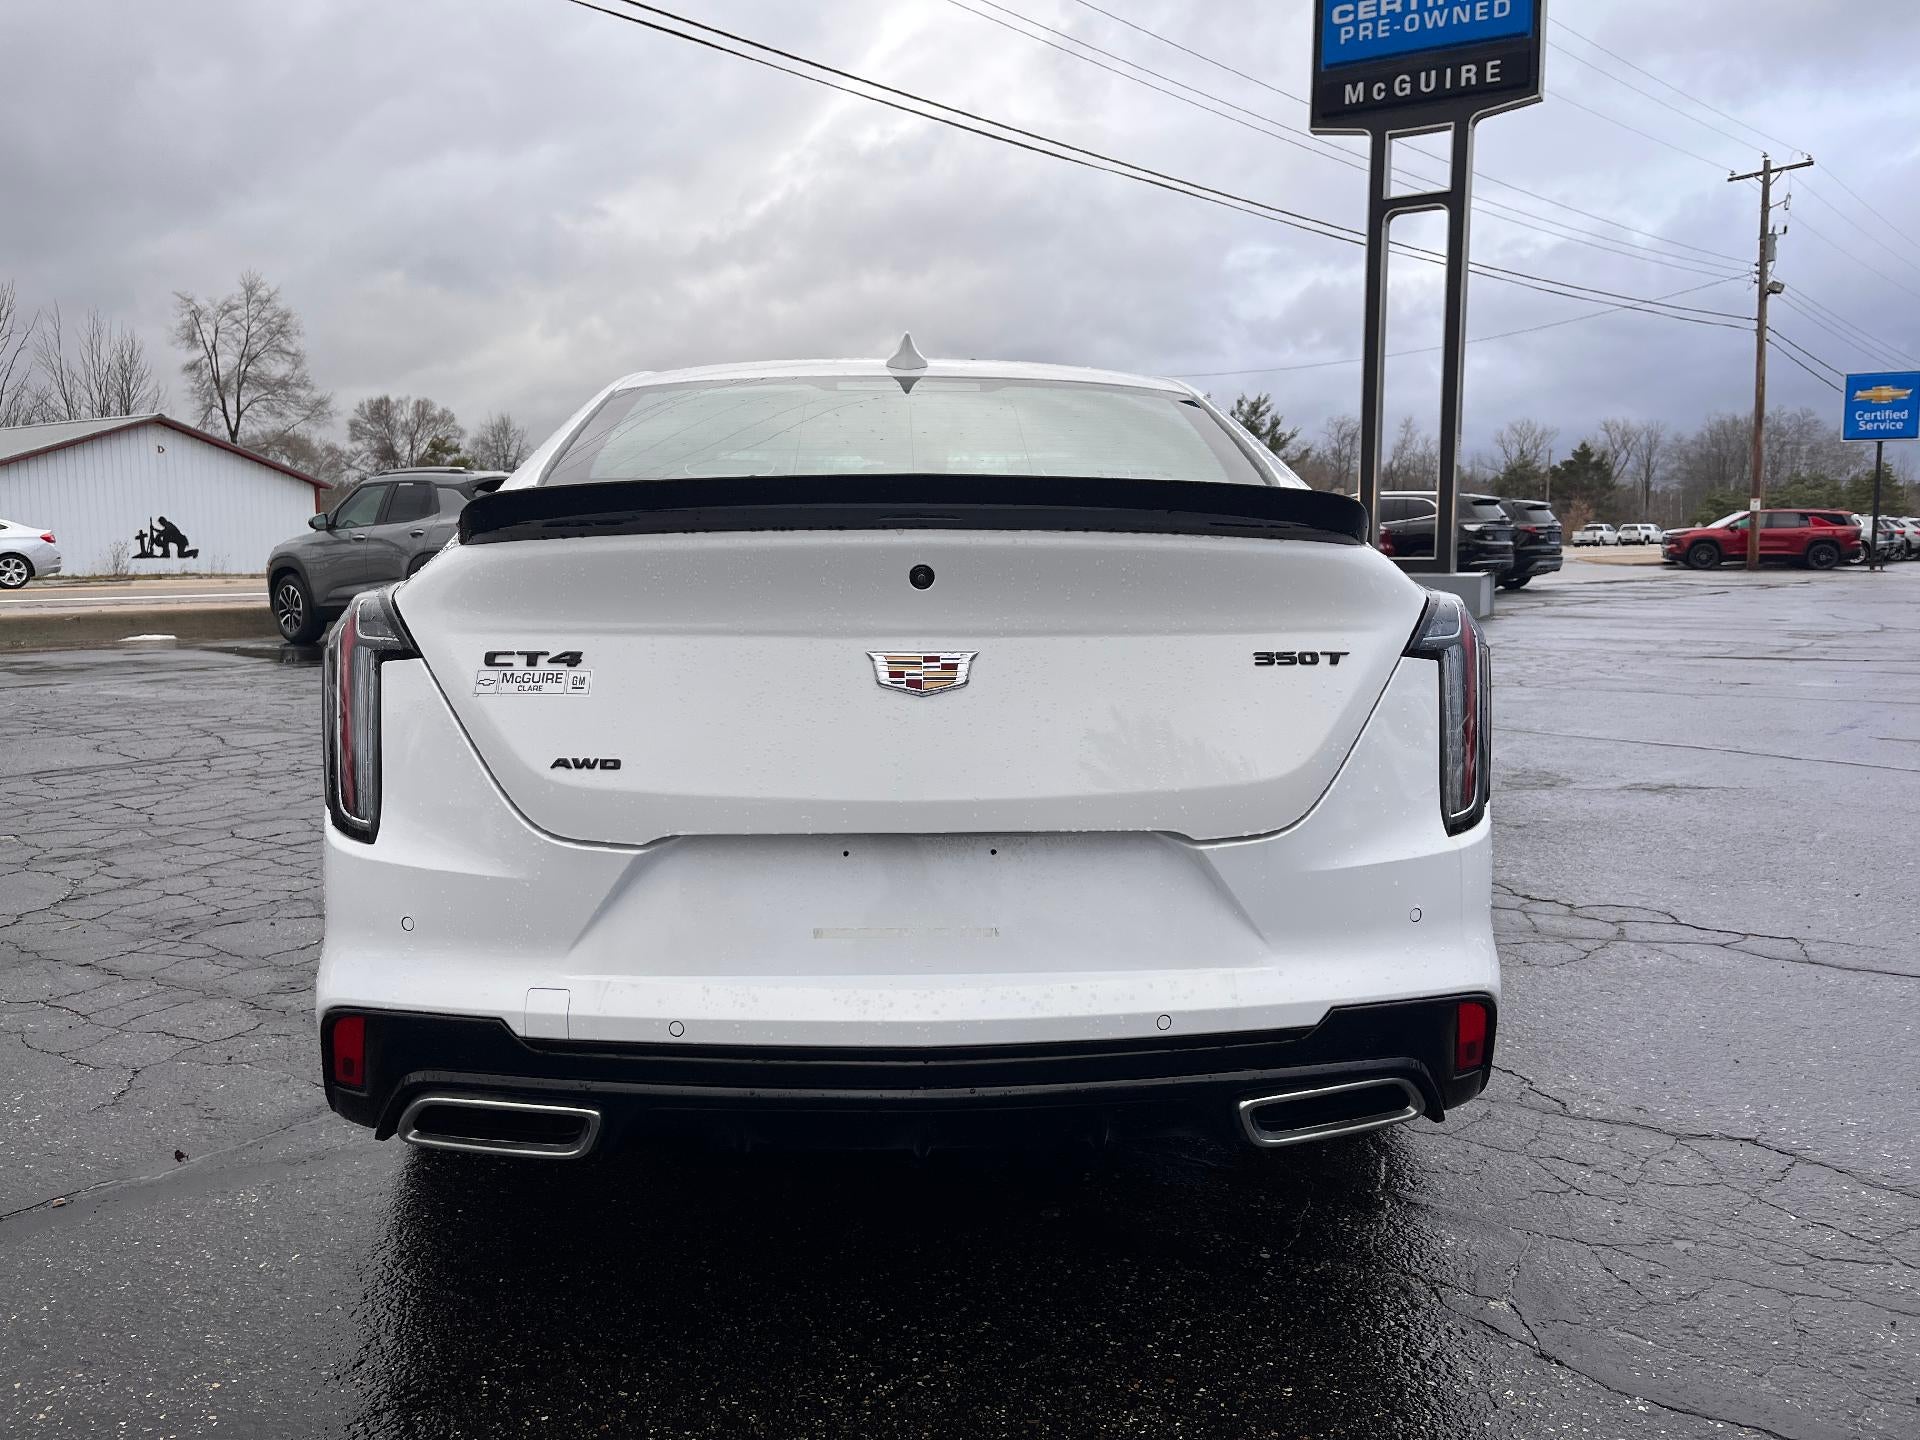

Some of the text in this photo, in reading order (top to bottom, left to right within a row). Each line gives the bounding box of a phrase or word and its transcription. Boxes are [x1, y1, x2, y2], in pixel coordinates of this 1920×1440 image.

[1340, 0, 1511, 45] PRE-OWNED
[1344, 60, 1502, 105] McGUIRE
[1855, 409, 1909, 421] Certified
[1858, 420, 1904, 431] Service
[484, 650, 584, 668] CT4
[1253, 651, 1351, 666] 350T
[501, 672, 564, 684] McGUIRE
[572, 676, 586, 686] GM
[550, 757, 622, 770] AWD
